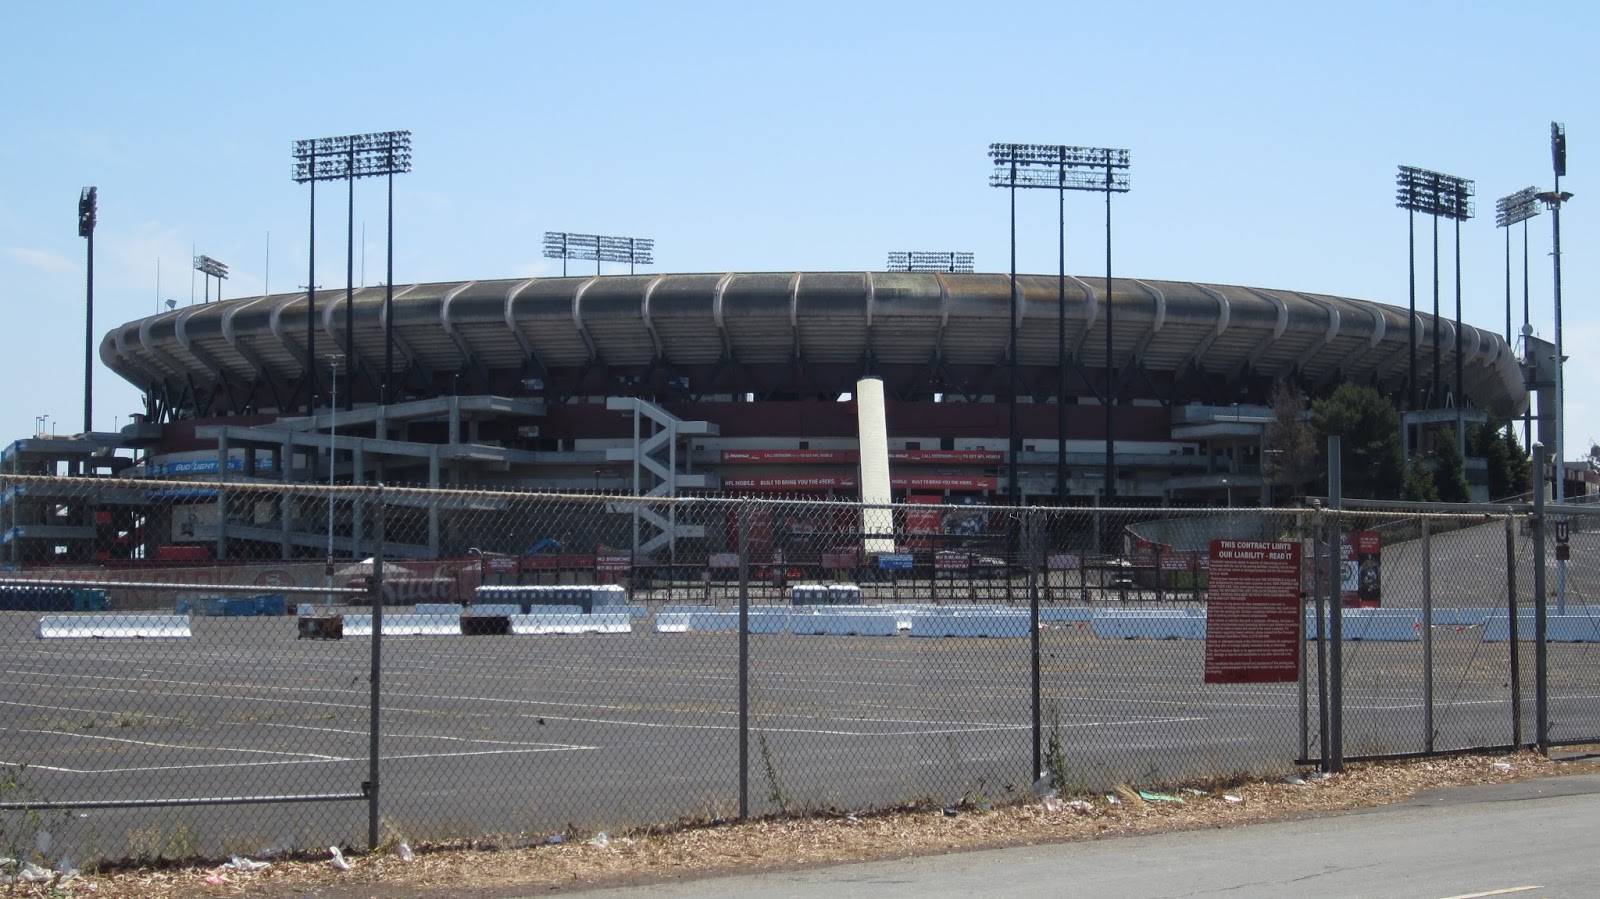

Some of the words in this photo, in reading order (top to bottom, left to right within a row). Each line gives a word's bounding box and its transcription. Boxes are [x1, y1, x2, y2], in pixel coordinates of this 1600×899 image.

[175, 462, 191, 471] BUD
[192, 462, 215, 470] LIGHT
[1237, 542, 1270, 550] CONTRACT
